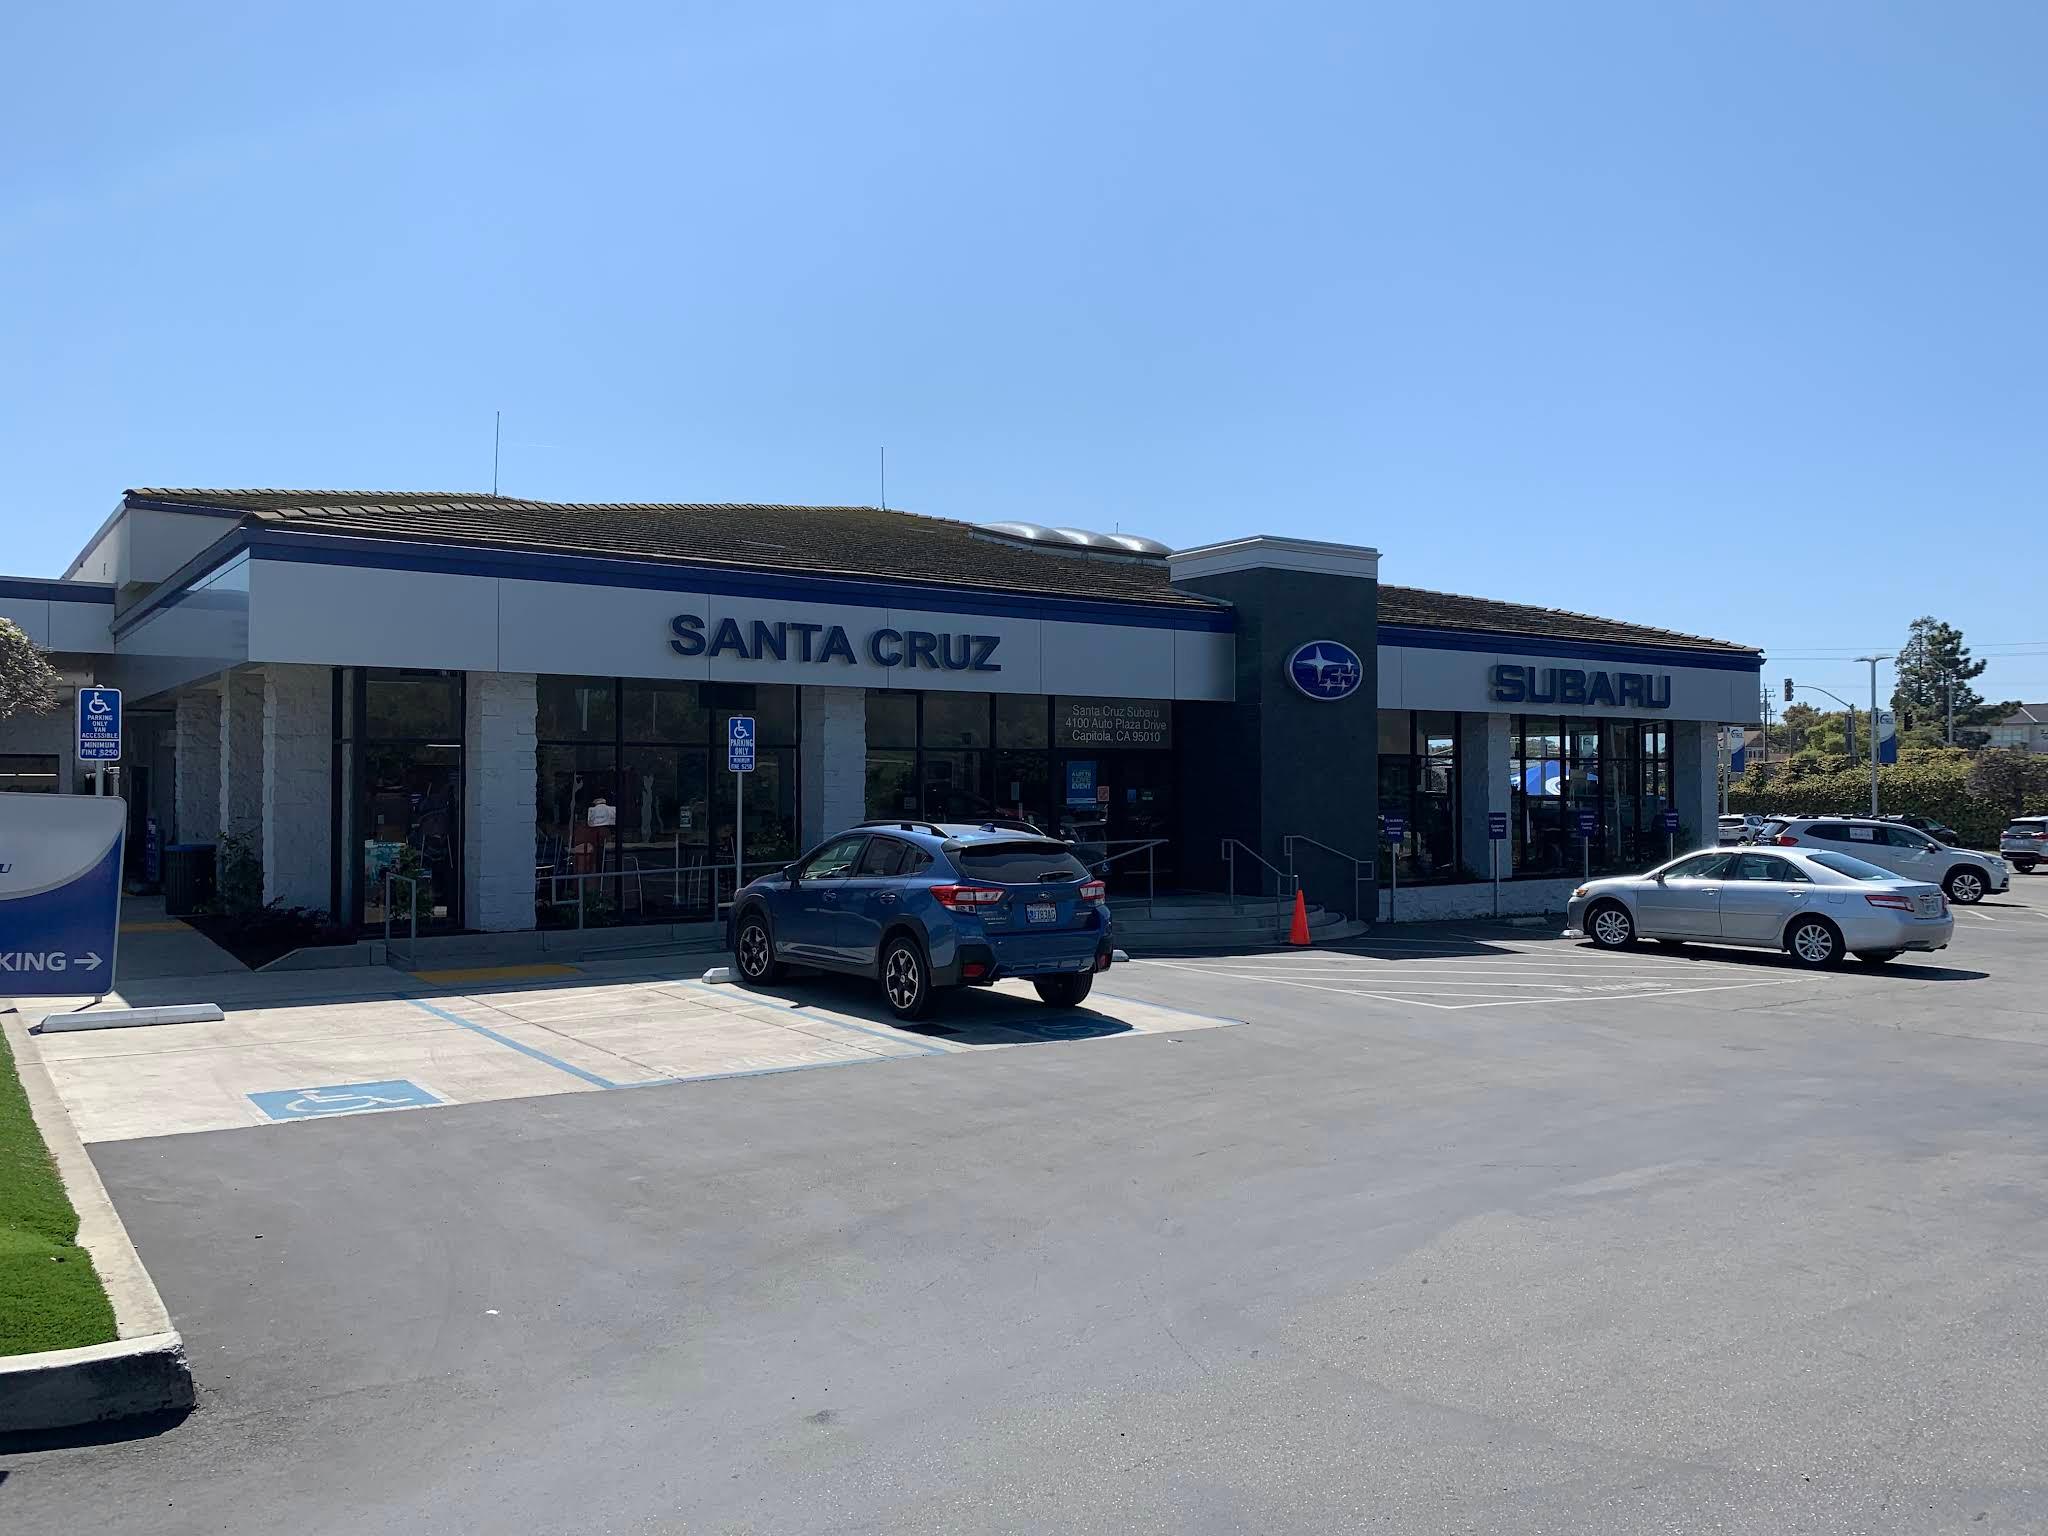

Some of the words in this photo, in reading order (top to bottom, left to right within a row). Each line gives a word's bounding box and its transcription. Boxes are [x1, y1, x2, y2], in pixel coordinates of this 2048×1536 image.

[670, 614, 858, 665] SANTA
[871, 628, 1002, 672] CRUZ
[1494, 664, 1671, 709] SUBARU
[1072, 704, 1100, 717] Santa
[1102, 705, 1125, 717] Cruz
[1126, 706, 1160, 718] Subaru
[1065, 717, 1090, 729] 4100
[1091, 718, 1113, 729] Auto
[1115, 718, 1141, 730] Plaza
[1143, 719, 1167, 731] Drive
[730, 738, 753, 747] PARKING
[1072, 729, 1114, 744] Capitola,
[1116, 730, 1131, 742] CA
[1132, 731, 1161, 743] 95010
[84, 741, 116, 749] MINIMUM
[734, 747, 749, 756] ONLY
[81, 748, 97, 756] FINE
[99, 748, 118, 757] $250
